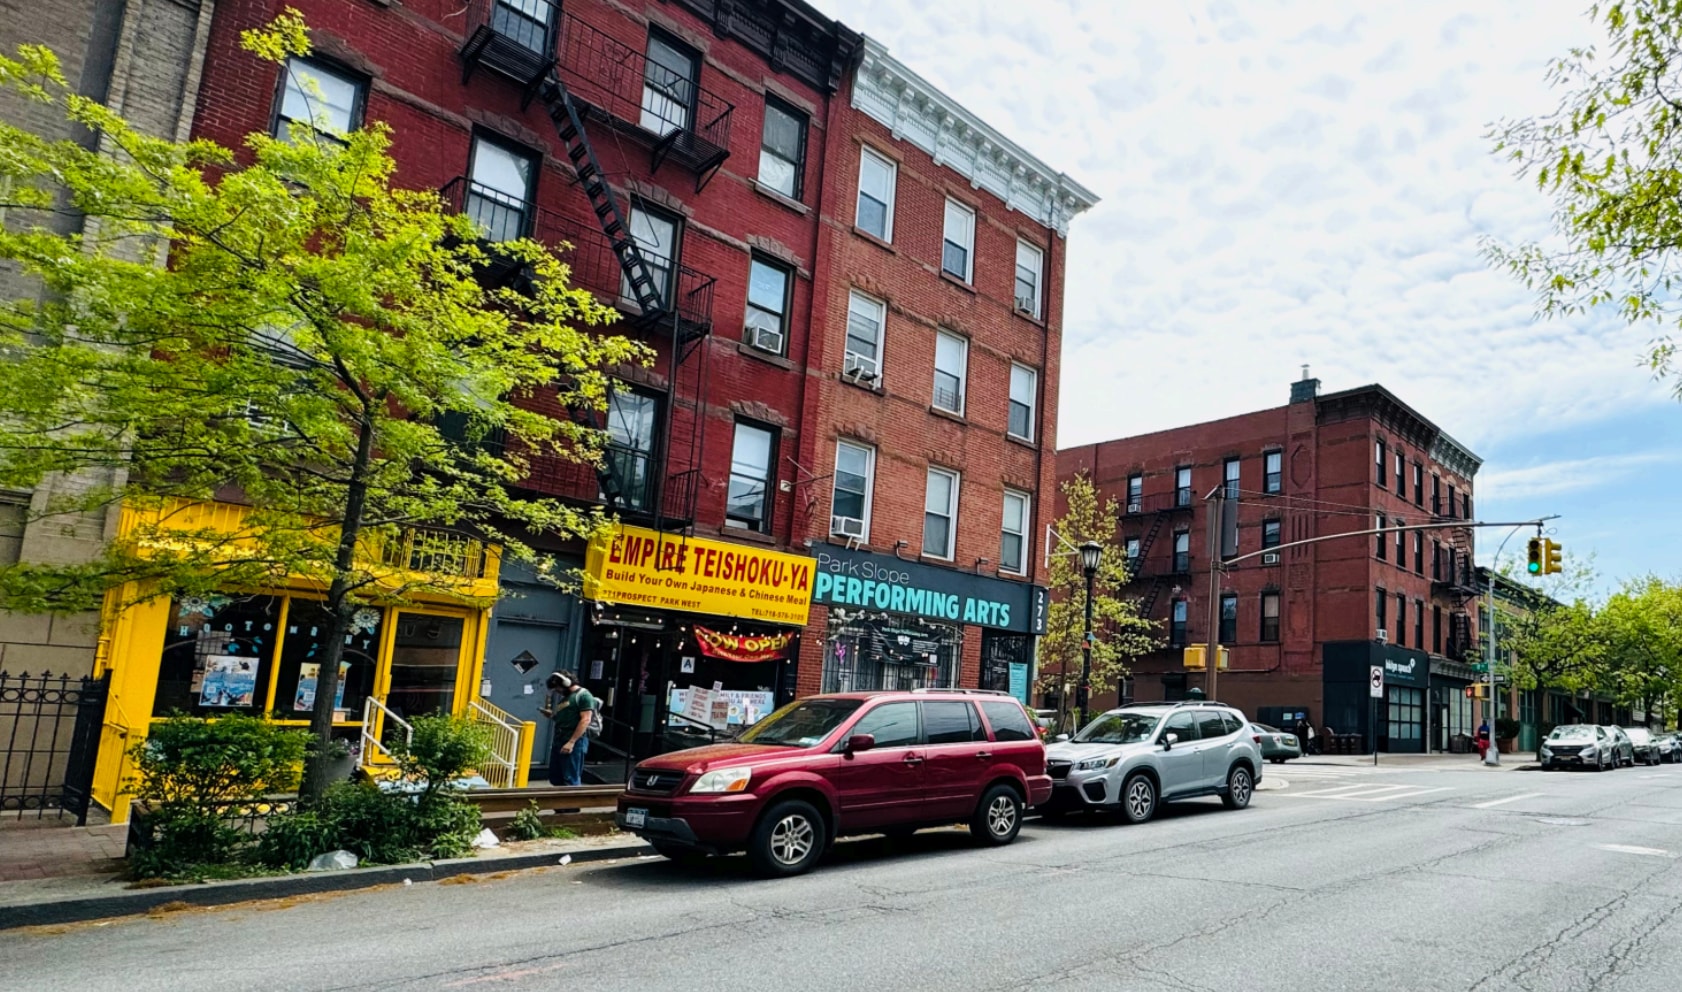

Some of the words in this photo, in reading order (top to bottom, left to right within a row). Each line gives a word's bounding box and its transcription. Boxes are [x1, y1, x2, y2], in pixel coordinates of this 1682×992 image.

[609, 533, 689, 574] EMPIRE
[693, 546, 809, 591] TEISHOKU-YA
[818, 552, 859, 577] Park
[861, 561, 910, 585] Slope
[606, 569, 635, 583] Build
[638, 573, 663, 586] Your
[665, 578, 689, 590] Own
[690, 581, 737, 597] Japanese
[740, 588, 746, 598] &
[749, 588, 784, 603] Chinese
[786, 593, 807, 606] Meal
[660, 597, 679, 605] PARK
[681, 599, 701, 609] WEST
[815, 571, 960, 620] PERFORMING
[963, 597, 1011, 627] ARTS
[744, 636, 788, 651] OPEN
[684, 658, 692, 669] A
